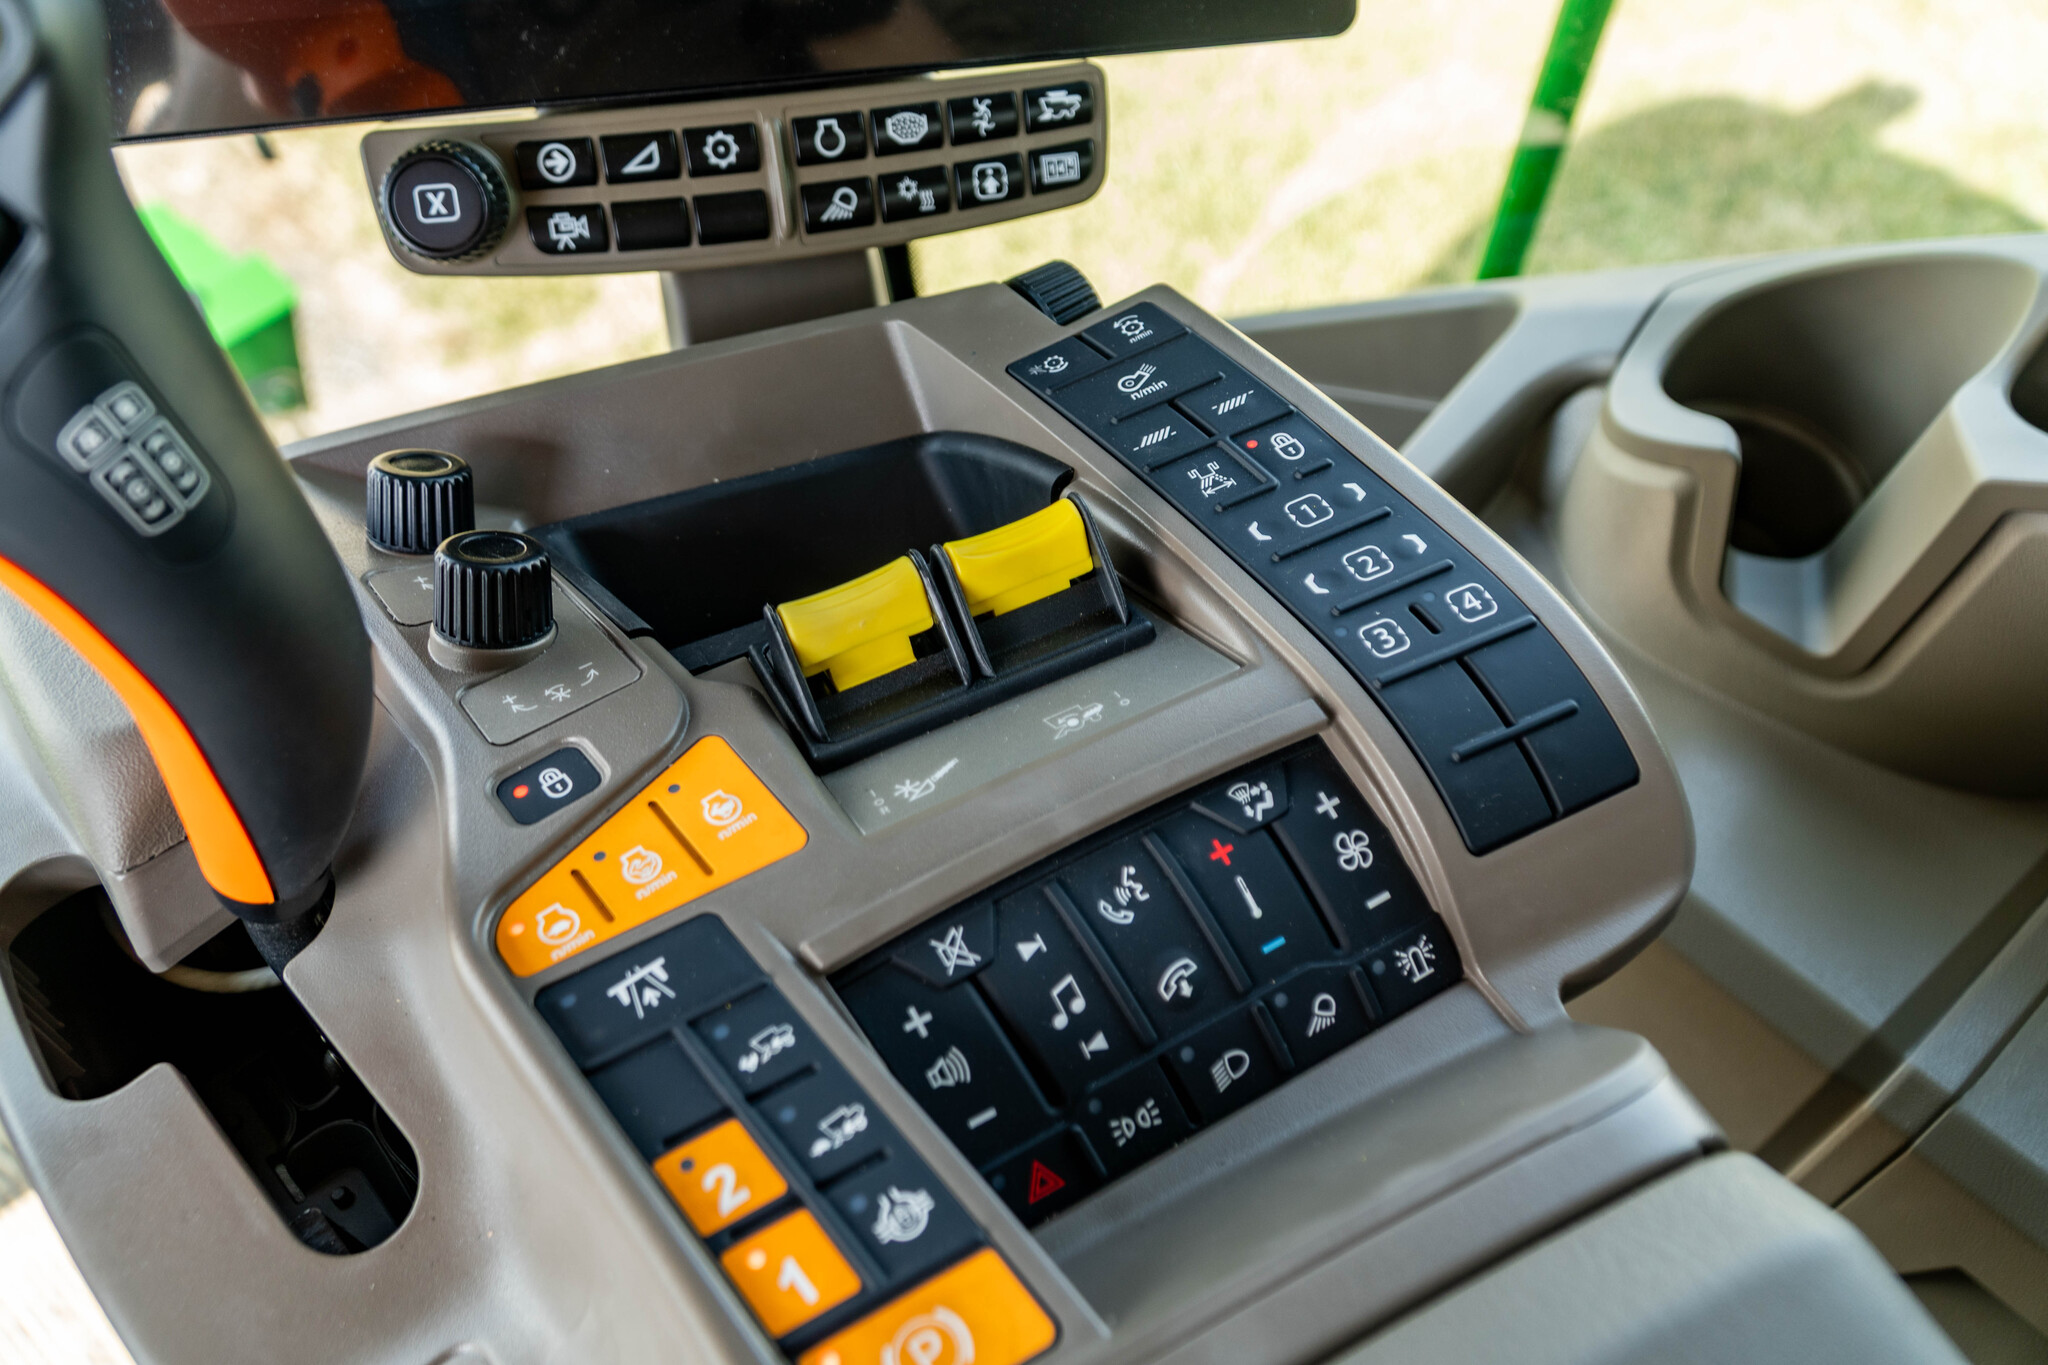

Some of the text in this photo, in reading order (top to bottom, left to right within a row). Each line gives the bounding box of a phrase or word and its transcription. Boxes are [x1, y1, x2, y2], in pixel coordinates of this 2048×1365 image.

[1130, 378, 1169, 401] n/min
[1300, 504, 1317, 519] 1
[1357, 556, 1379, 574] 2
[1462, 591, 1482, 611] 4
[1373, 627, 1396, 649] 3
[703, 1164, 751, 1217] 2
[779, 1257, 820, 1305] 1
